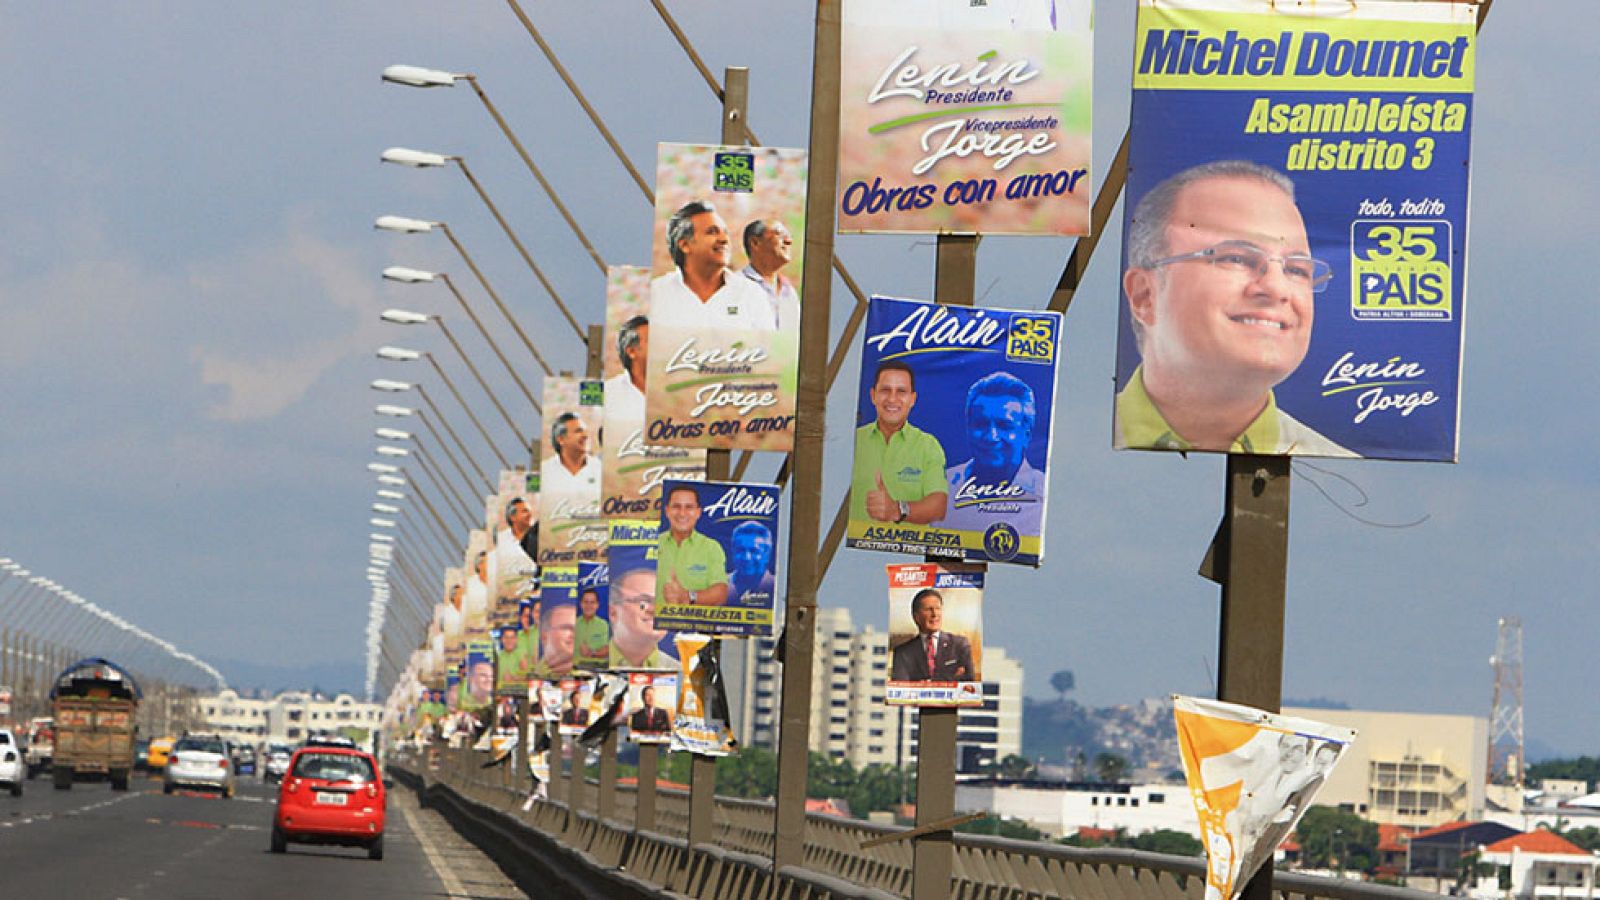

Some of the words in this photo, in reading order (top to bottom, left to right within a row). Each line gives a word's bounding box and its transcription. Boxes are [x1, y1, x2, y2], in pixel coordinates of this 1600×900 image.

[1138, 28, 1292, 76] Michel
[1294, 32, 1470, 78] Doumet
[925, 86, 1013, 104] Presidente
[965, 116, 1058, 133] Vicepresidente
[1244, 96, 1467, 134] Asambleísta
[719, 154, 750, 169] 35
[912, 119, 1057, 176] Jorge
[1286, 138, 1406, 172] distrito
[1412, 137, 1436, 171] 3
[842, 177, 938, 216] Obras
[943, 177, 997, 207] con
[1005, 168, 1087, 200] amor
[1358, 198, 1396, 217] todo,
[1399, 198, 1445, 215] todito
[1366, 226, 1438, 263] 35
[866, 305, 1006, 352] Alain
[1014, 317, 1052, 340] 35
[690, 383, 779, 418] Jorge
[1354, 387, 1440, 424] Jorge
[647, 418, 705, 441] Obras
[708, 418, 741, 436] con
[745, 414, 795, 434] amor
[602, 494, 652, 516] Obras
[703, 487, 779, 518] Alain
[863, 525, 961, 547] ASAMBLEÍSTA
